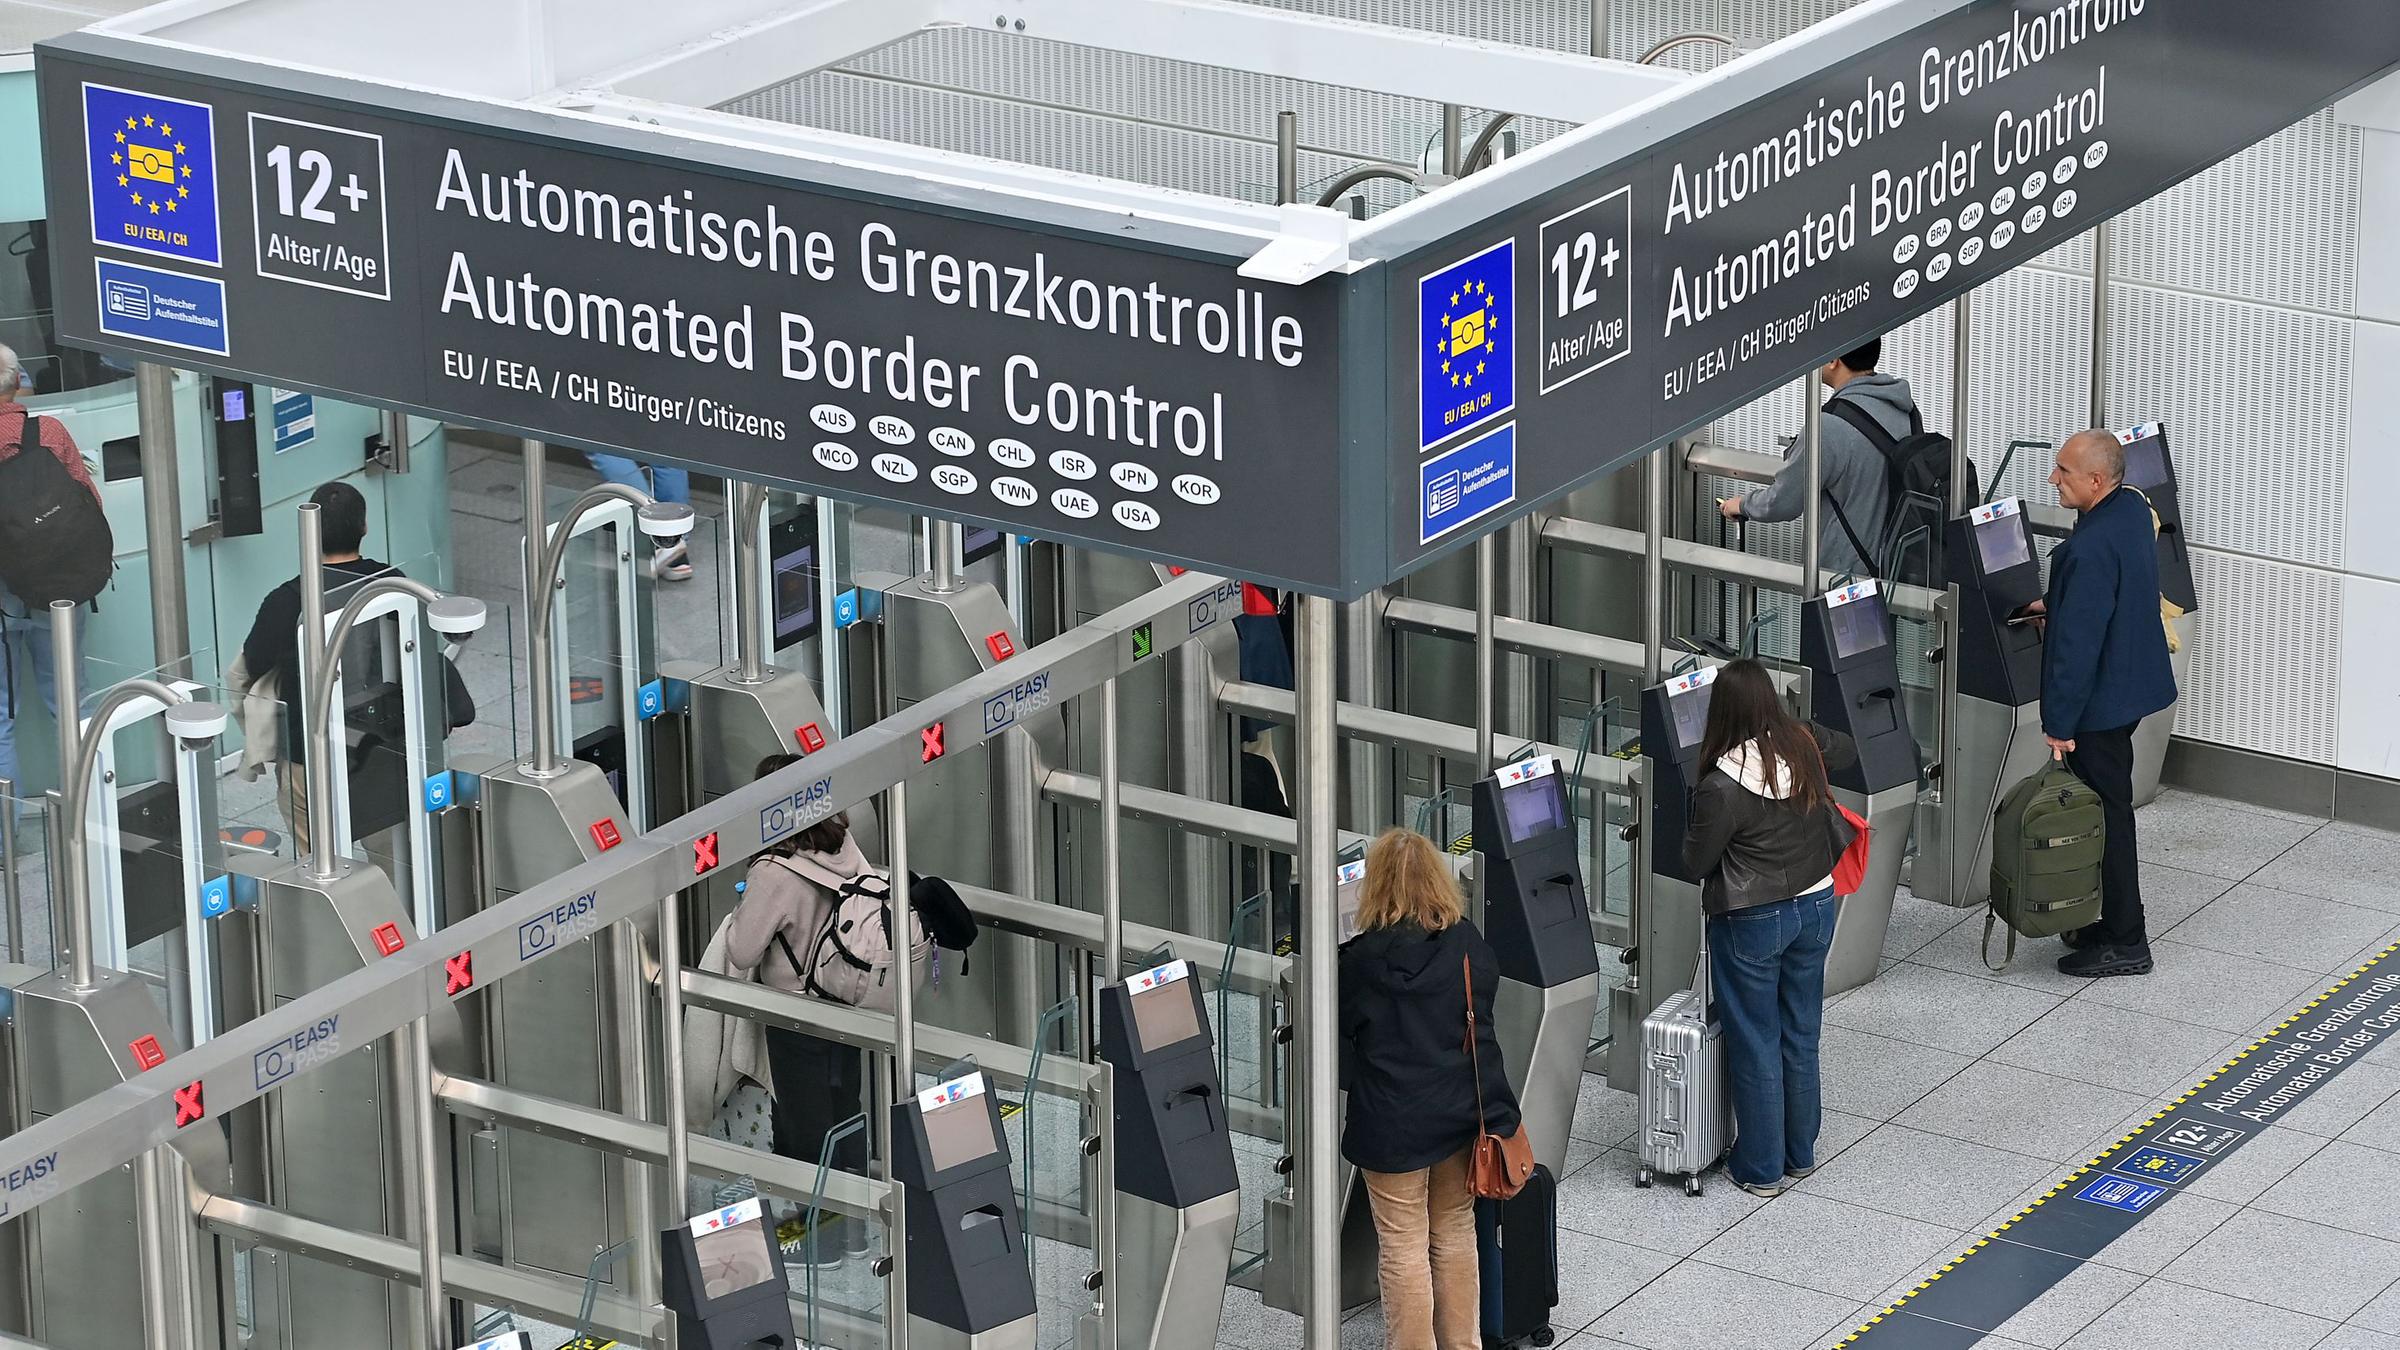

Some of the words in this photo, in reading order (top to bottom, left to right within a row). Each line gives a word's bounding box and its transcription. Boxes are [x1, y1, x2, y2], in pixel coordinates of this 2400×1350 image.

[1664, 76, 1906, 236] Automatische
[267, 145, 368, 225] 12+
[1664, 195, 1855, 338] Automated
[1871, 140, 1982, 234] Border
[1993, 65, 2105, 176] Control
[1897, 239, 1914, 259] AUS
[1931, 223, 1947, 242] BRA
[1962, 207, 1979, 226] CAN
[1995, 192, 2010, 209] CHL
[2028, 176, 2041, 193] ISR
[2056, 161, 2072, 179] JPN
[2087, 145, 2104, 163] KOR
[124, 223, 138, 237] EU
[146, 227, 166, 242] EEA
[173, 233, 188, 247] CH
[1897, 274, 1916, 293] MCO
[1931, 258, 1947, 276] NZL
[1962, 242, 1979, 260] SGP
[1994, 226, 2011, 243] TWN
[2026, 210, 2042, 227] UAE
[2057, 195, 2072, 212] USA
[435, 148, 835, 282] Automatische
[860, 222, 1304, 368] Grenzkontrolle
[1551, 230, 1620, 320] 12+
[153, 294, 197, 311] Deutscher
[155, 307, 219, 328] Aufenthaltstitel
[441, 252, 754, 371] Automated
[780, 311, 981, 412] Border
[1003, 354, 1225, 462] Control
[1664, 366, 1684, 401] EU
[1686, 362, 1693, 392] /
[1697, 347, 1726, 384] EEA
[1729, 340, 1736, 371] /
[1740, 329, 1760, 362] CH
[443, 349, 474, 381] EU
[479, 357, 489, 386] /
[496, 359, 543, 394] EEA
[550, 371, 561, 399] /
[567, 374, 600, 404] CH
[1444, 411, 1456, 425] EU
[1460, 401, 1476, 418] EEA
[1481, 392, 1492, 408] CH
[818, 410, 848, 427] AUS
[877, 421, 907, 439] BRA
[935, 433, 966, 451] CAN
[997, 445, 1027, 462] CHL
[1061, 457, 1085, 474] ISR
[1119, 468, 1147, 486] JPN
[1180, 479, 1212, 498] KOR
[1462, 460, 1494, 482] Deutscher
[819, 448, 852, 465] MCO
[881, 459, 910, 477] NZL
[939, 470, 969, 488] SGP
[998, 482, 1031, 500] TWN
[1059, 494, 1090, 512] UAE
[1121, 506, 1152, 525] USA
[1462, 465, 1510, 496] Aufenthaltstitel
[1217, 580, 1242, 603] EAS
[1015, 671, 1050, 702] EASY
[1016, 689, 1050, 719] PASS
[794, 775, 832, 809] EASY
[795, 794, 833, 827] PASS
[557, 890, 597, 925] EASY
[557, 910, 598, 942] PASS
[294, 1014, 339, 1051] EASY
[296, 1035, 340, 1071] PASS
[2202, 1043, 2311, 1113] Automatische
[2240, 1063, 2331, 1122] Automated
[2313, 1028, 2377, 1065] Border
[2168, 1125, 2207, 1145] 12+
[9, 1152, 57, 1191] EASY
